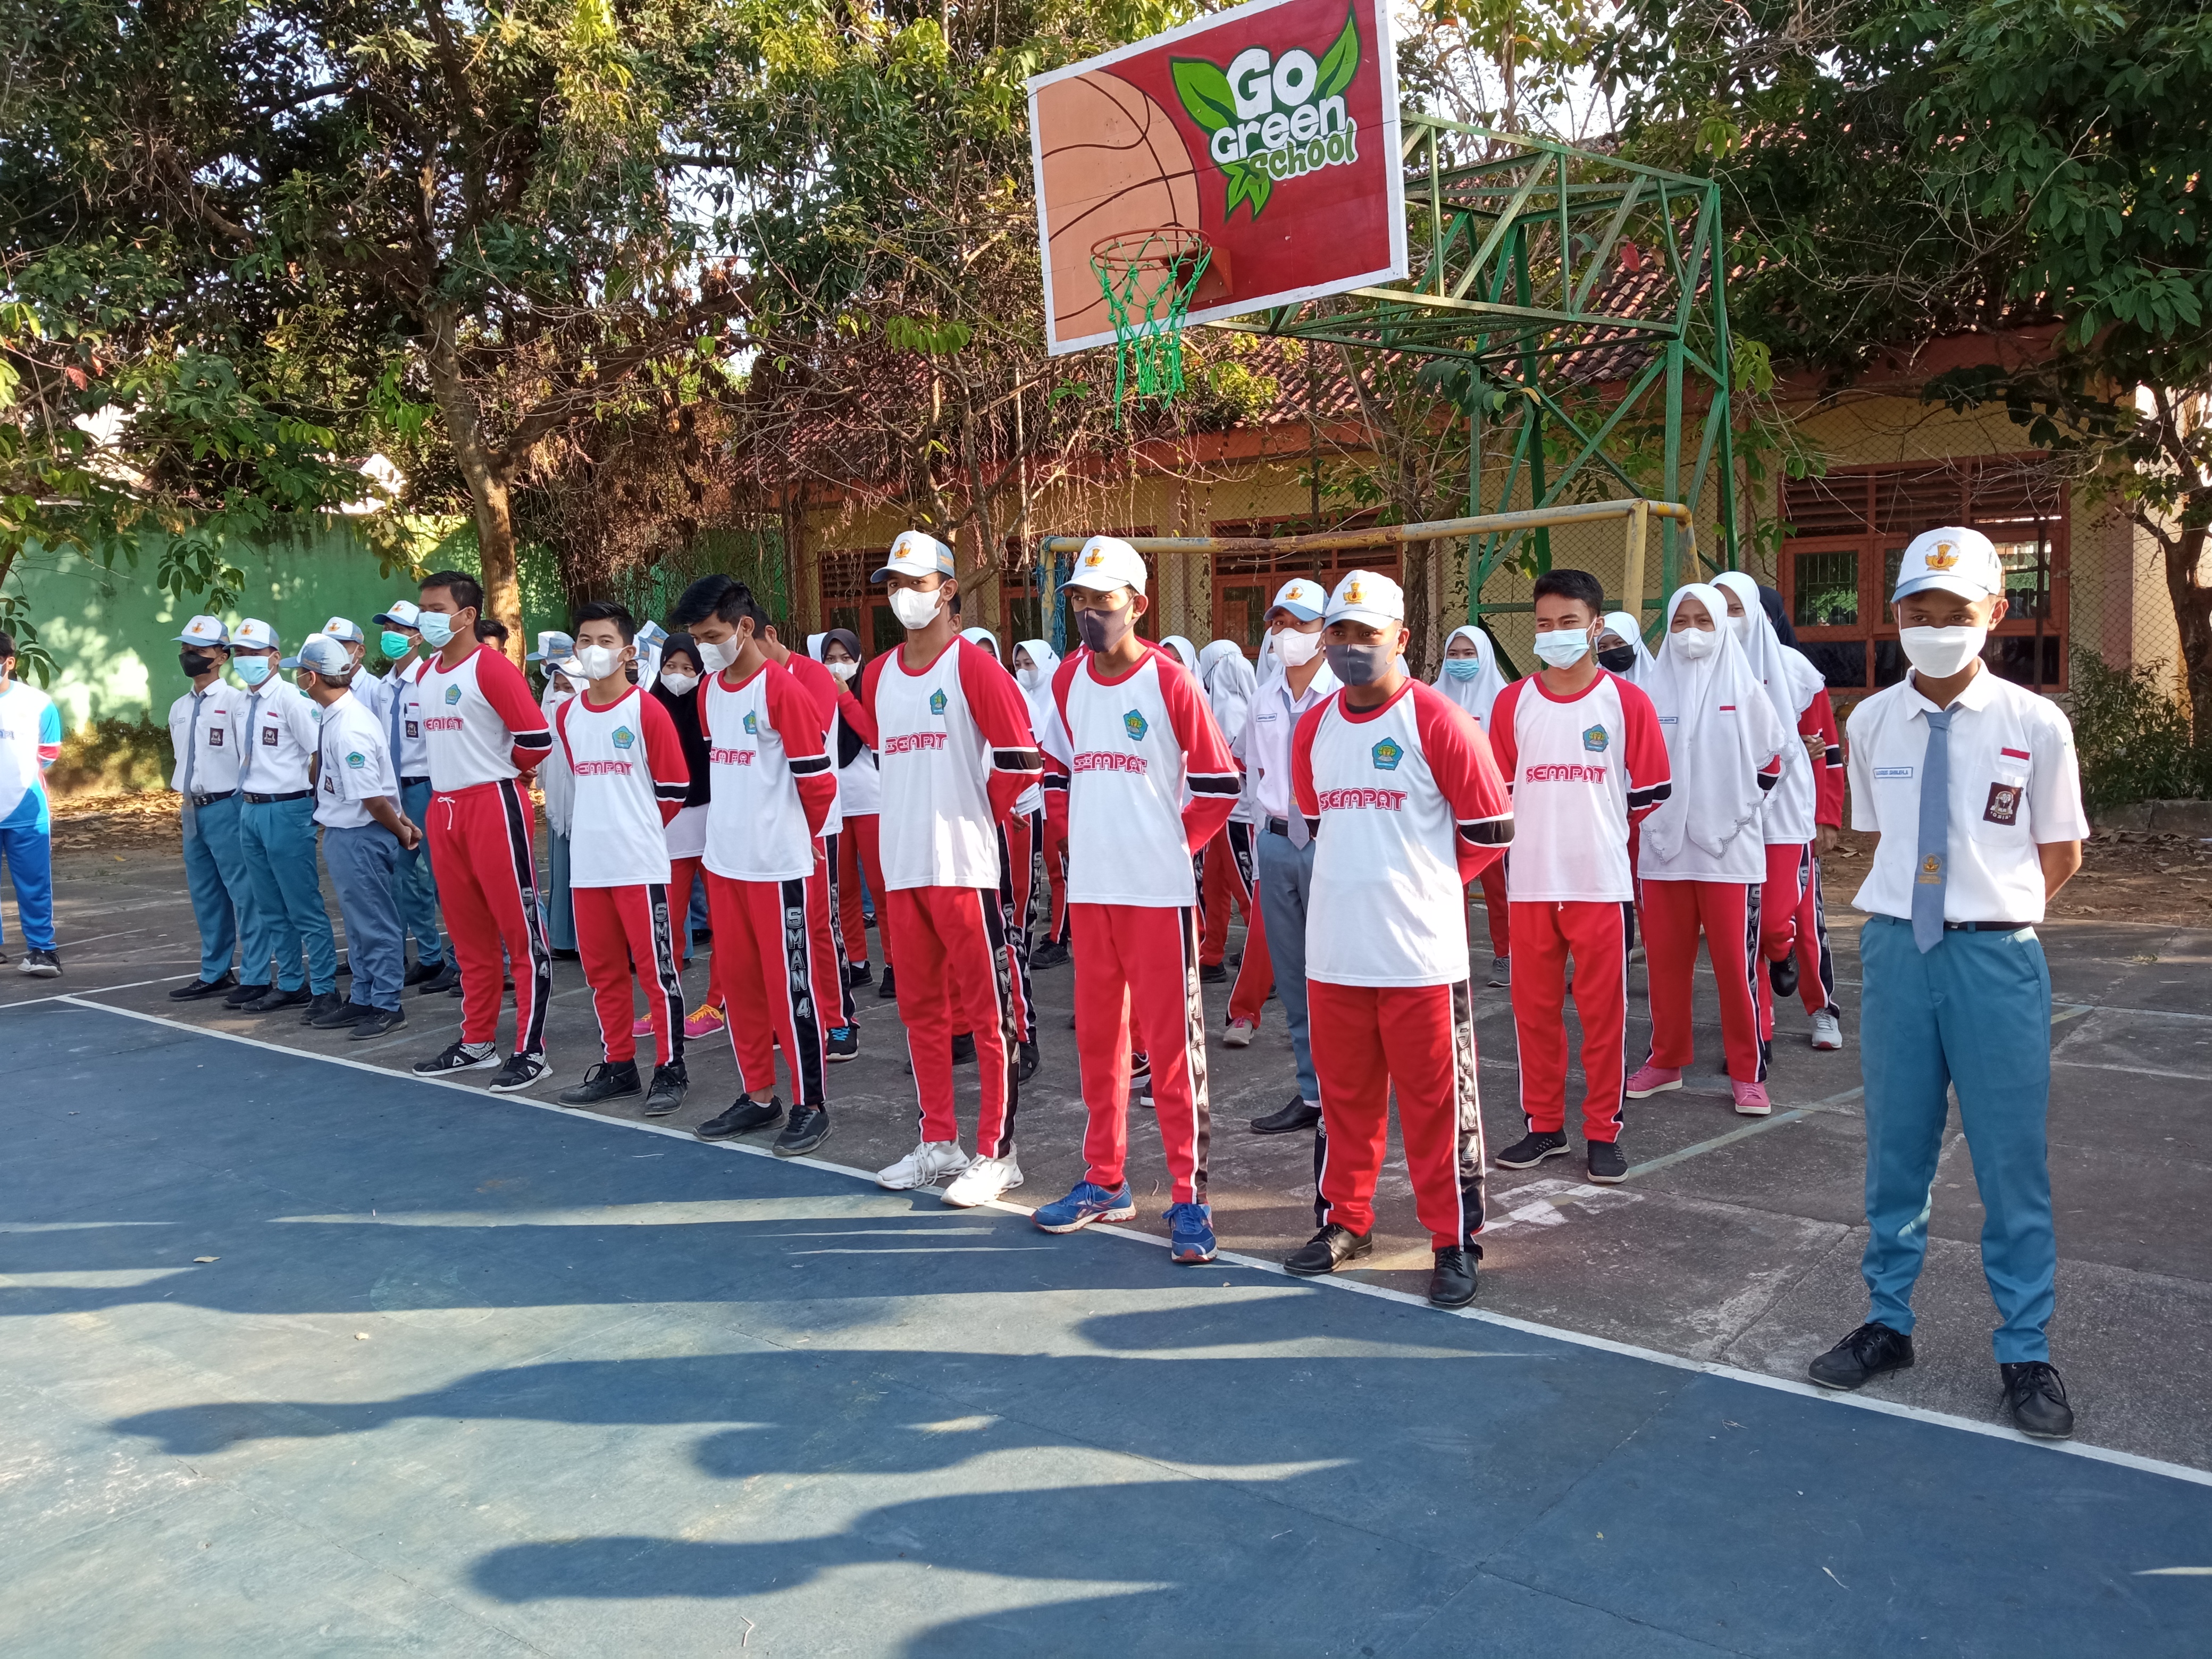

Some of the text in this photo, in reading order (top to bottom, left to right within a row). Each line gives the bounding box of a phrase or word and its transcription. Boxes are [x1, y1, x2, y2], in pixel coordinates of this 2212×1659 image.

[1211, 95, 1346, 163] Green
[1526, 763, 1607, 784] SEMPAT
[1318, 787, 1408, 812] SEMPAT
[538, 960, 549, 978] 4
[654, 902, 680, 997] SMAN 4
[786, 907, 811, 1018] SMAN 4
[1187, 966, 1208, 1107] SMAN 4
[1462, 1135, 1479, 1163] 4
